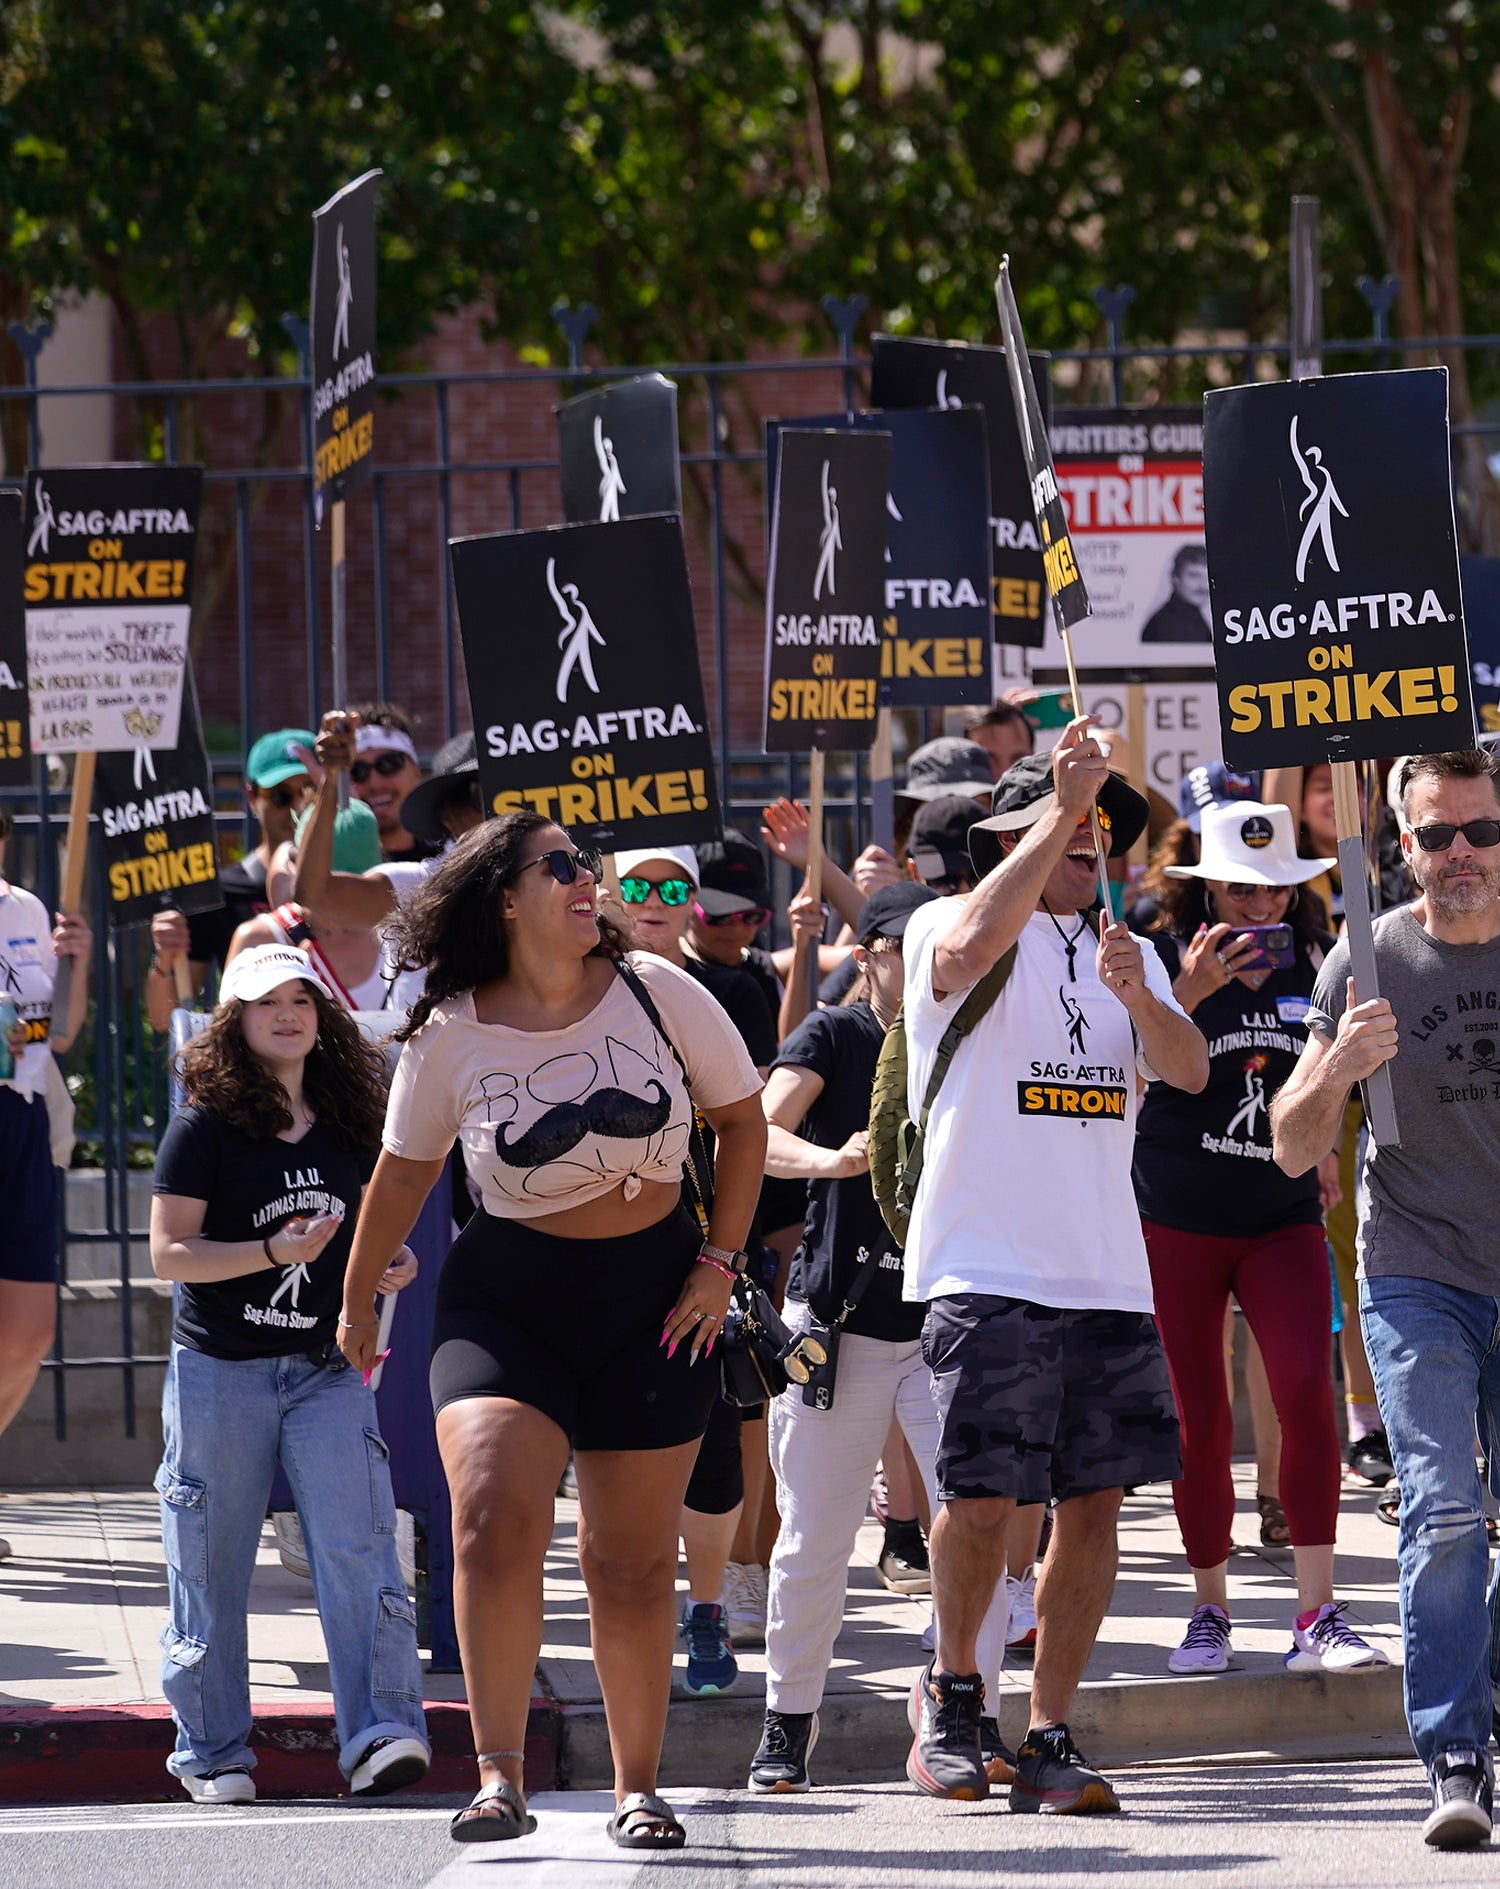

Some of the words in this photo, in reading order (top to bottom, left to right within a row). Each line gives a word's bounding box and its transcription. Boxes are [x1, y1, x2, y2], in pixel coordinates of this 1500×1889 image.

[1050, 425, 1148, 453] WRITERS
[88, 538, 124, 560] ON
[24, 560, 187, 602] STRIKE!
[812, 653, 834, 677] ON
[880, 638, 983, 677] IKE!
[1308, 644, 1353, 671] ON
[770, 678, 877, 721] STRIKE!
[1228, 665, 1459, 733] STRIKE!
[571, 752, 616, 778] ON
[144, 831, 168, 854] ON
[109, 842, 216, 901] STRIKE!
[1411, 1005, 1449, 1042] LOS
[1208, 1030, 1253, 1059] LATINAS
[1253, 1031, 1291, 1051] ACTING
[479, 1029, 664, 1122] BON
[1436, 1085, 1488, 1104] Derby
[284, 1167, 325, 1189] L.A.U.
[252, 1193, 296, 1229] LATINAS
